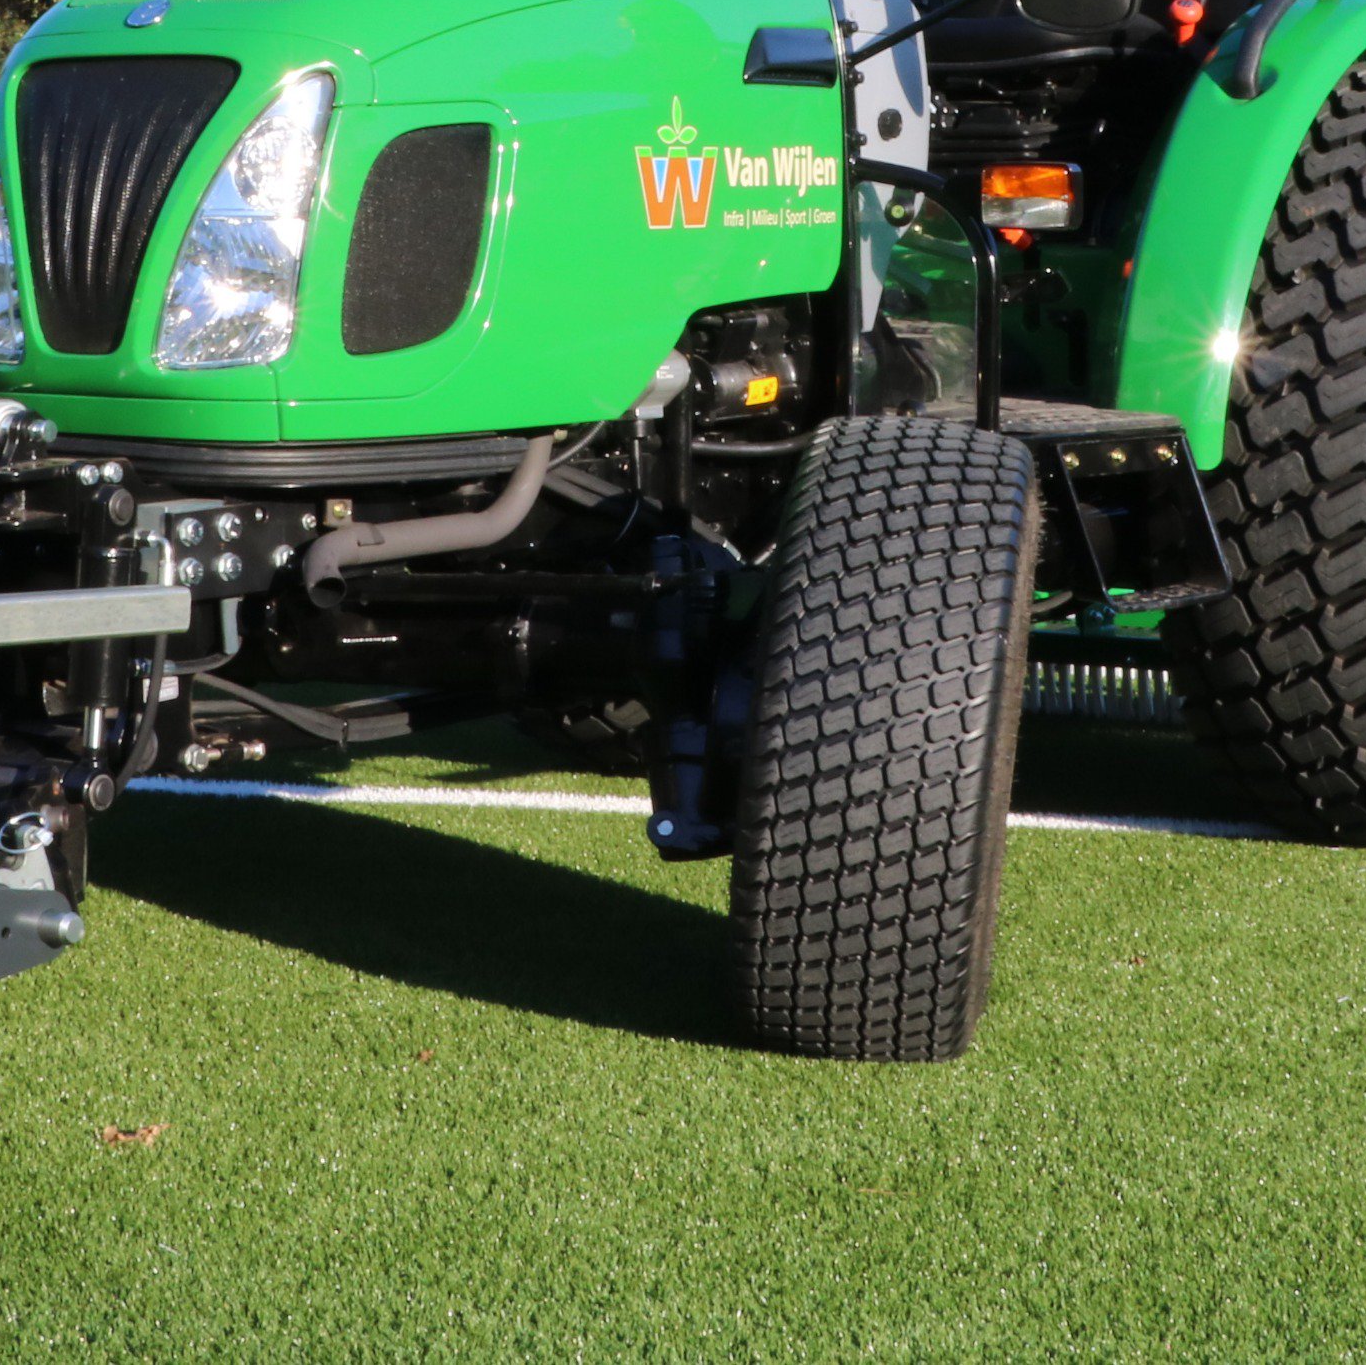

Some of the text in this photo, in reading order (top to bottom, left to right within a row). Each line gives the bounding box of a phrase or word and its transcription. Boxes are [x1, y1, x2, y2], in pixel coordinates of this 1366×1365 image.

[724, 146, 836, 197] Van Wijlen
[723, 208, 836, 227] Infra Milieu Sport Groen
